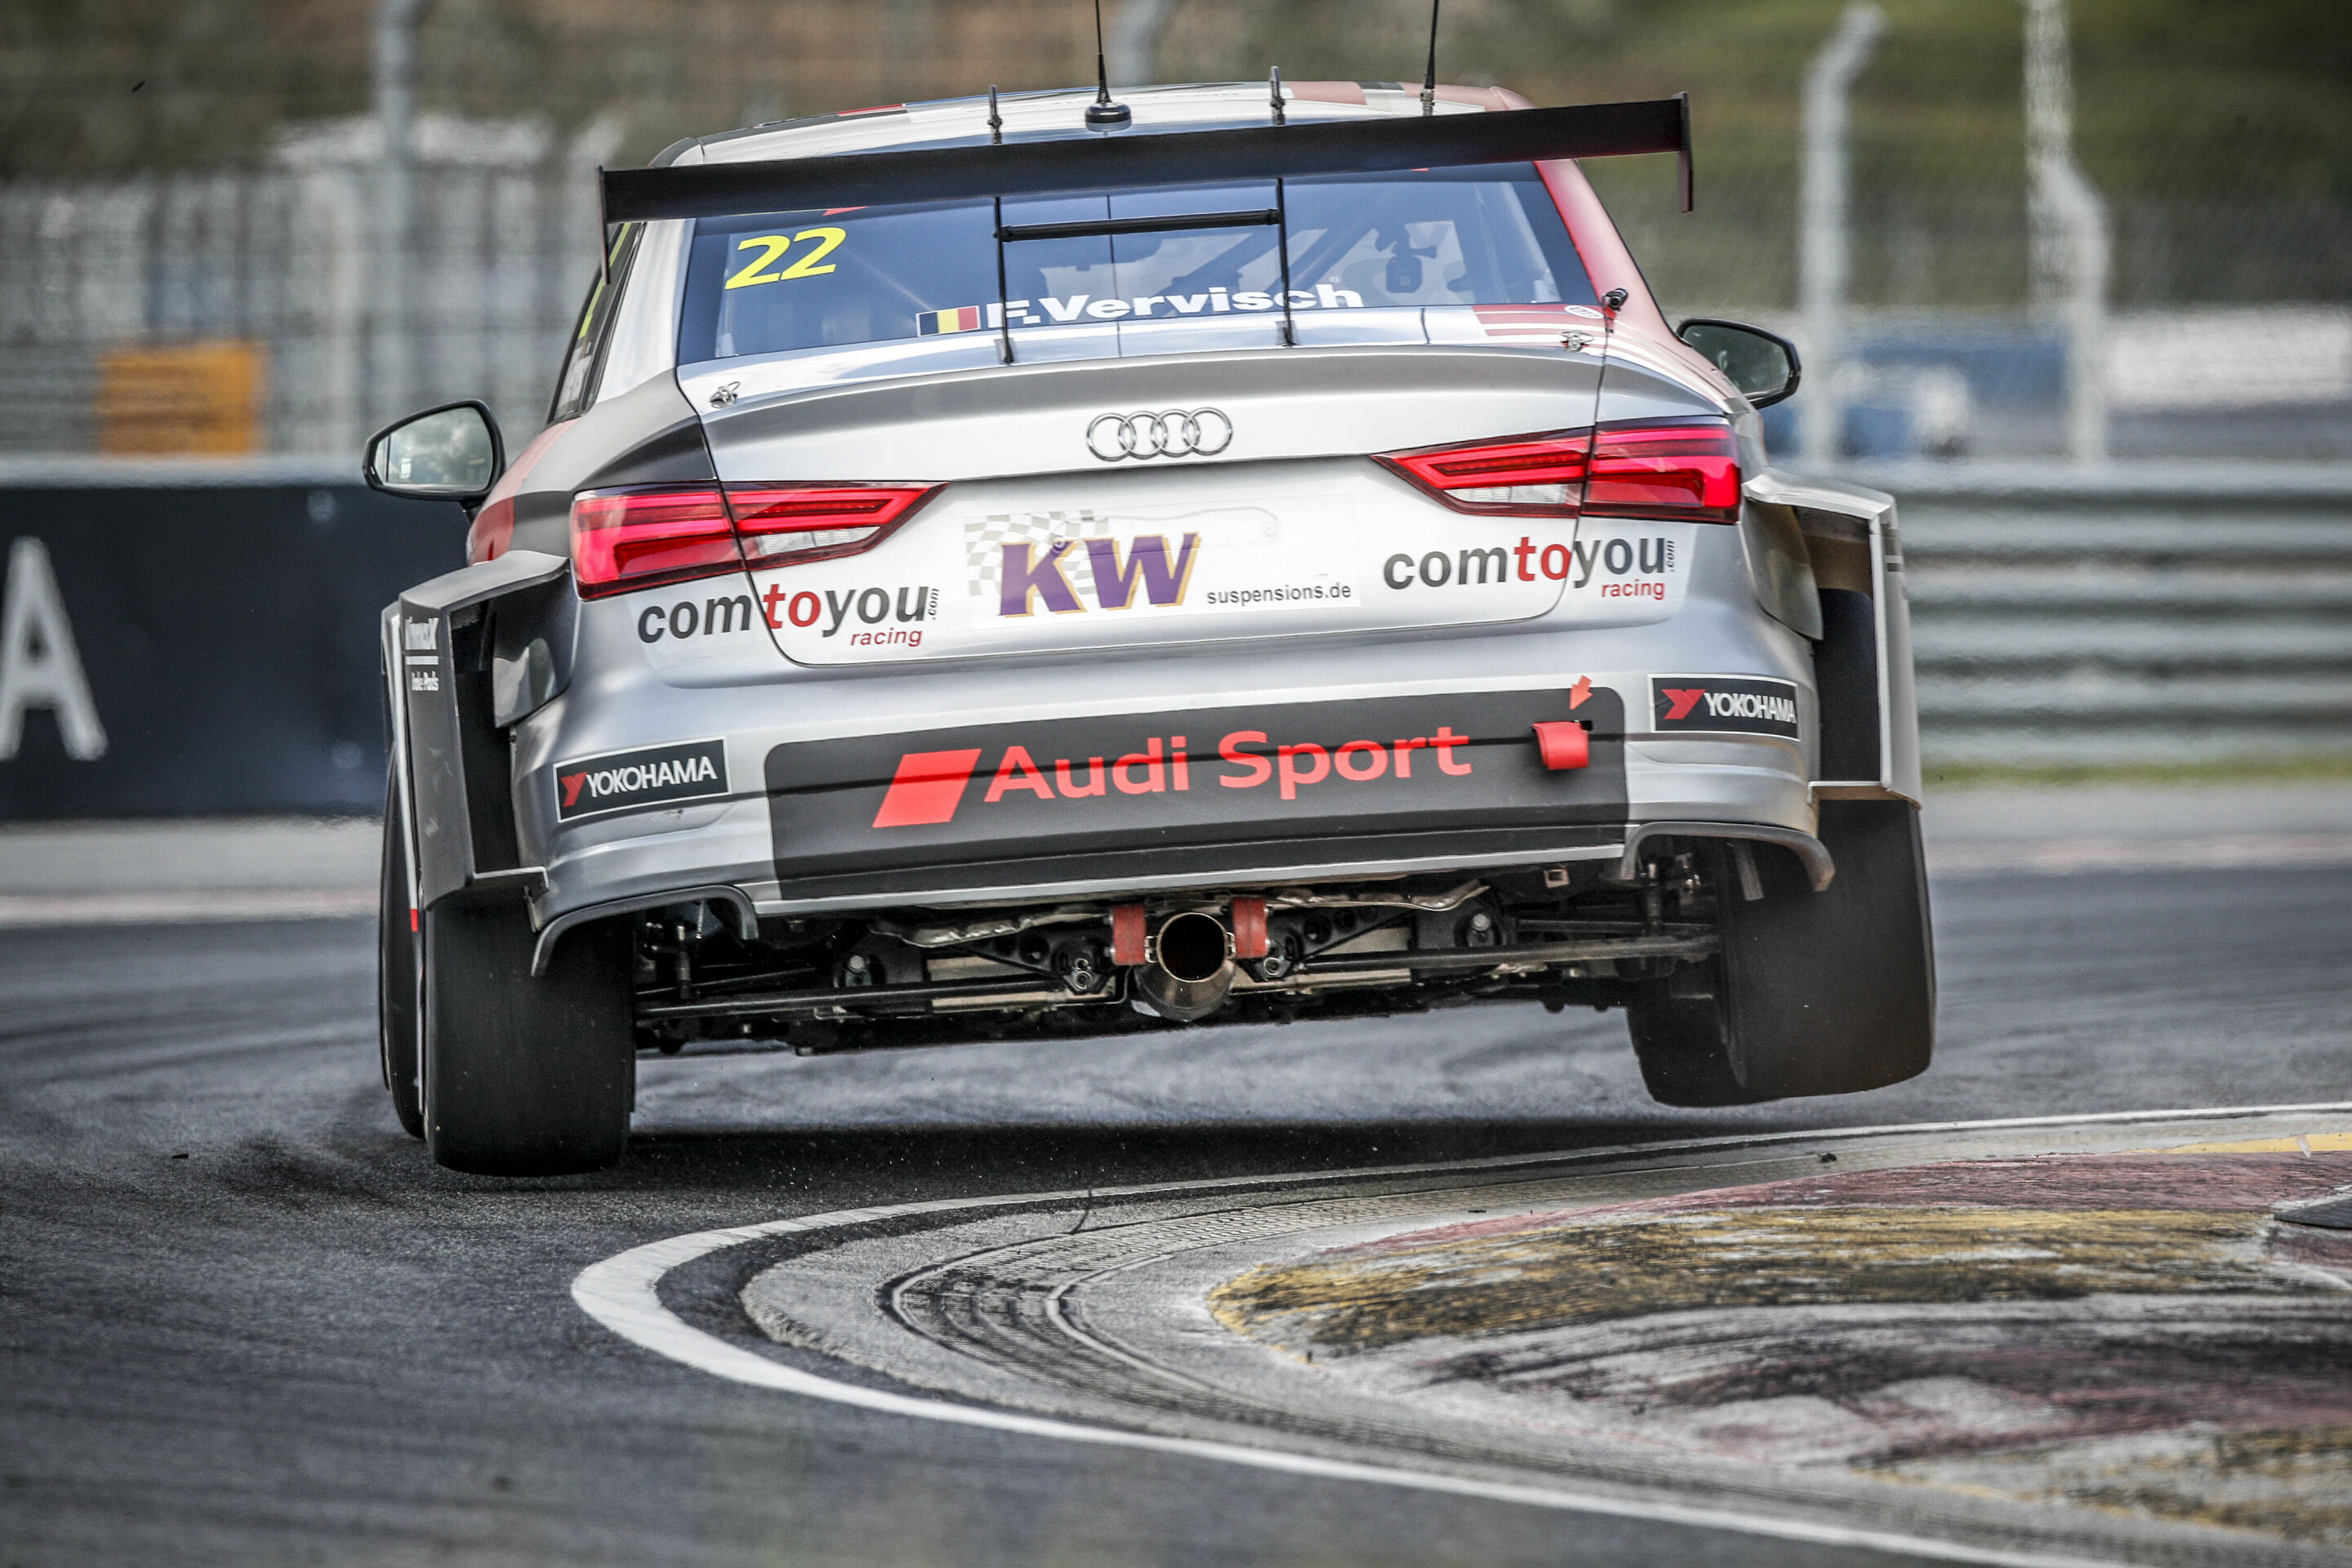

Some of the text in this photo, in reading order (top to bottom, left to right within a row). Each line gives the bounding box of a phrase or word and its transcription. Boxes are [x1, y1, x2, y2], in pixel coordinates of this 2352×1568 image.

[724, 227, 847, 290] 22
[986, 283, 1365, 328] F.Vervisch
[999, 532, 1201, 618] KW
[1383, 537, 1665, 590] comtoyou
[638, 583, 929, 644] comtoyou
[1207, 581, 1352, 607] suspensions.de
[1601, 579, 1665, 600] racing
[0, 536, 109, 761] A
[850, 629, 923, 647] racing
[1704, 692, 1797, 724] YOKOHAMA
[586, 756, 718, 797] YOKOHAMA
[984, 726, 1473, 803] Audi Sport
